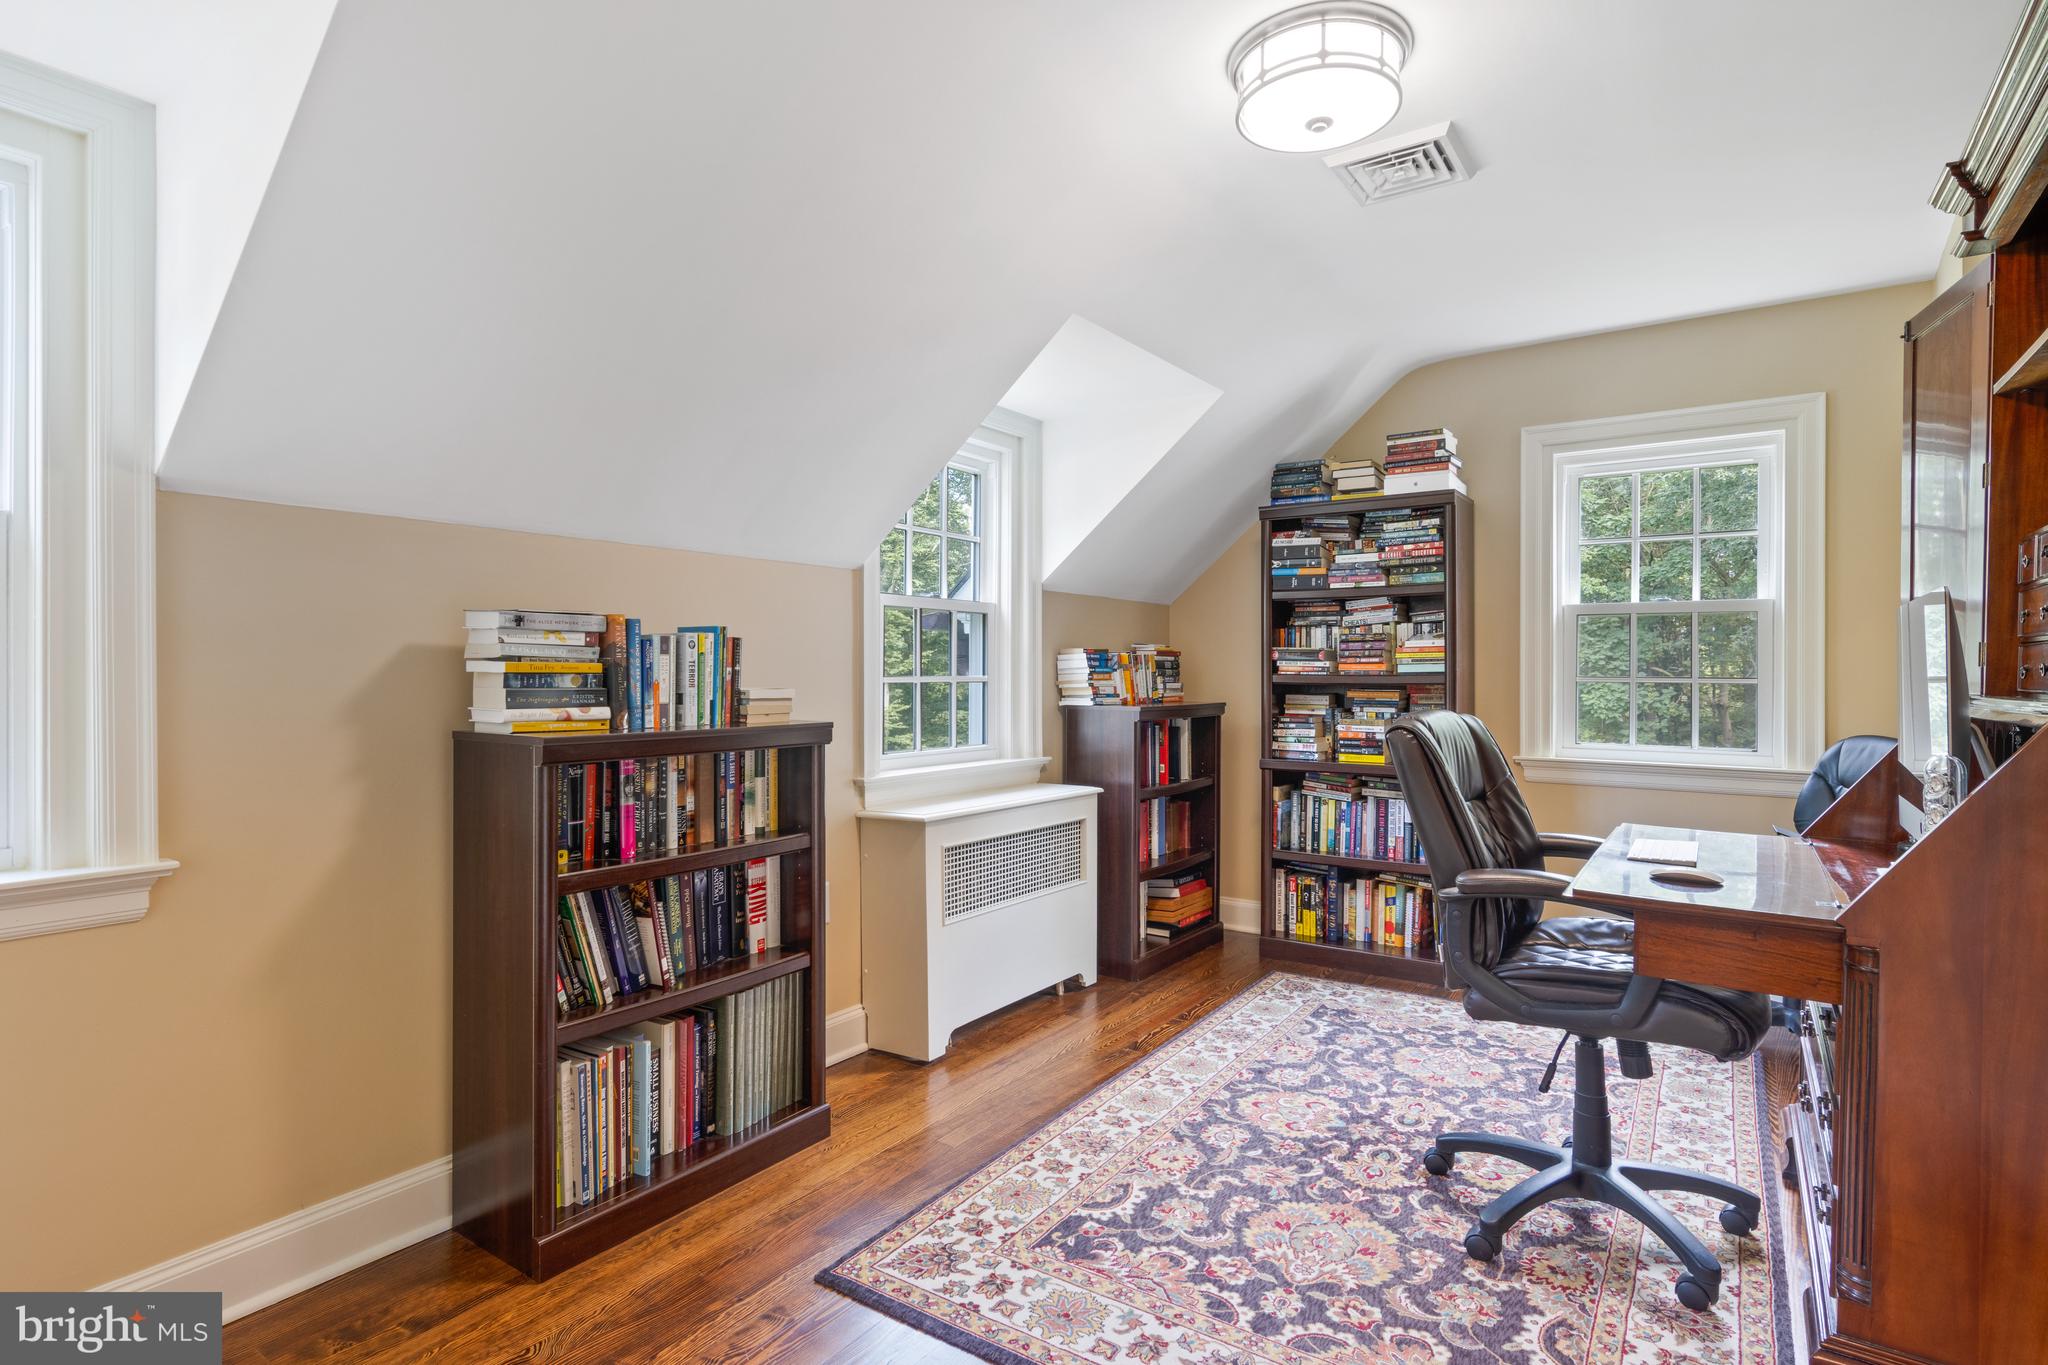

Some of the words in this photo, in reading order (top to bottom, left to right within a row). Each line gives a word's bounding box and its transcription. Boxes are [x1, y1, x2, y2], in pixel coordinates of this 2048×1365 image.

[635, 658, 641, 666] OF
[688, 660, 696, 688] TERROR
[527, 696, 559, 704] Nightingale
[563, 810, 568, 820] OF
[748, 882, 767, 926] KING
